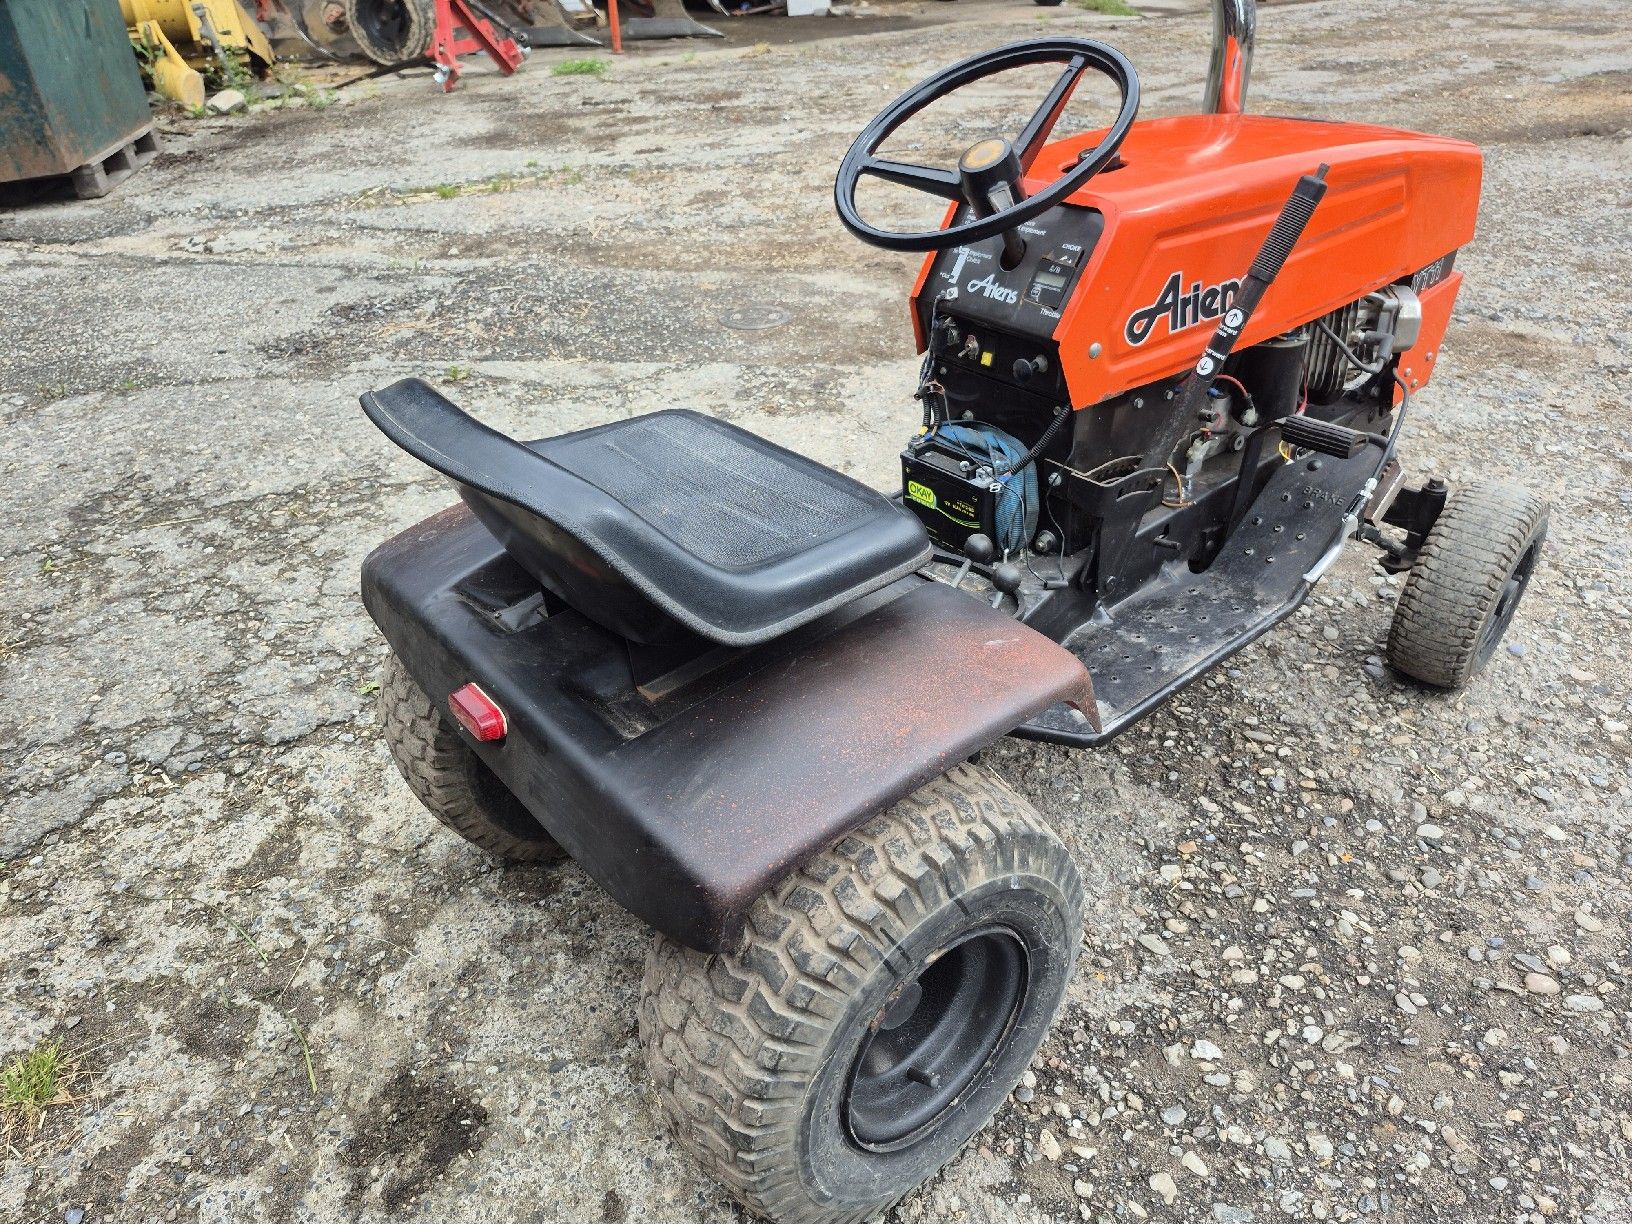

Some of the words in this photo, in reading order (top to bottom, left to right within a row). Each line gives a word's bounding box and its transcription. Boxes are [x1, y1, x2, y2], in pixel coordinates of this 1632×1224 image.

[1062, 243, 1082, 252] CHOKE
[966, 273, 1019, 305] Ariens
[1124, 271, 1247, 347] Arien
[910, 482, 932, 501] OKAY
[1302, 485, 1346, 507] BRAKE
